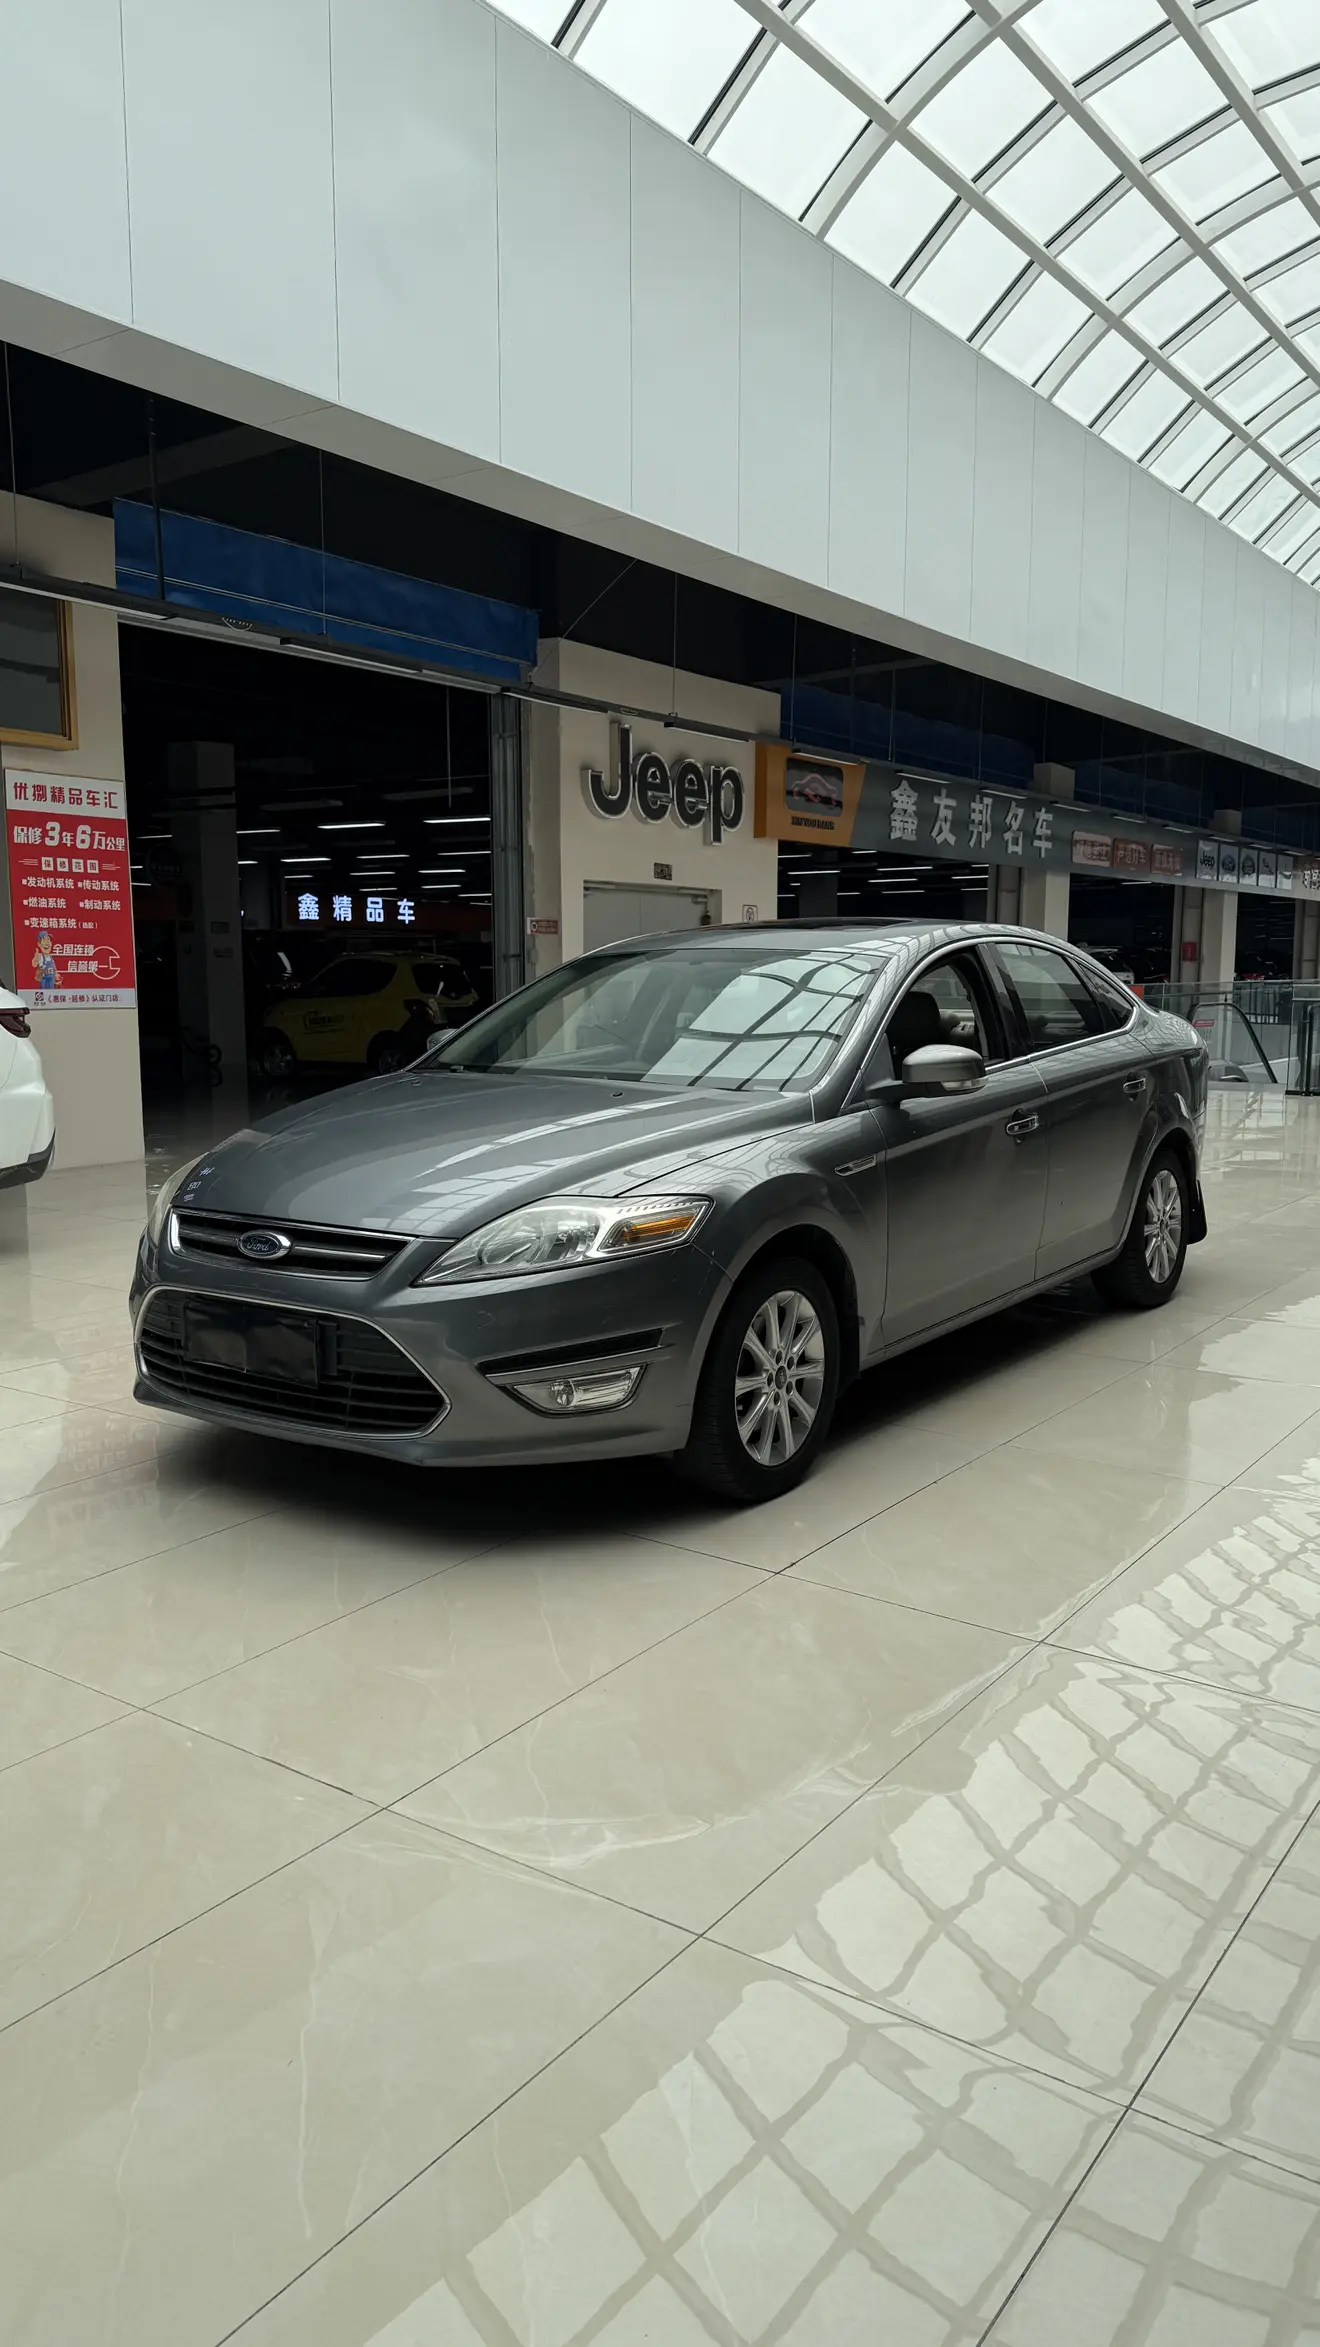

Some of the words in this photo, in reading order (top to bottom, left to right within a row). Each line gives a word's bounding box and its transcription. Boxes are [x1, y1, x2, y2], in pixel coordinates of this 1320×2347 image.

[583, 723, 745, 845] Jeep
[13, 781, 119, 809] 优捌精品车汇
[888, 779, 1054, 859] 鑫友邦名车
[13, 821, 126, 851] 保修3年6万公里
[43, 859, 97, 871] 保修范围
[1199, 851, 1216, 869] Jeep
[27, 876, 74, 889] 发动机系统
[83, 879, 120, 892] 传动系统
[28, 897, 67, 909] 燃油系统
[84, 898, 121, 911] 制动系统
[297, 892, 416, 925] 鑫精品车
[53, 943, 95, 955] 全国连锁
[246, 1237, 271, 1251] Ford
